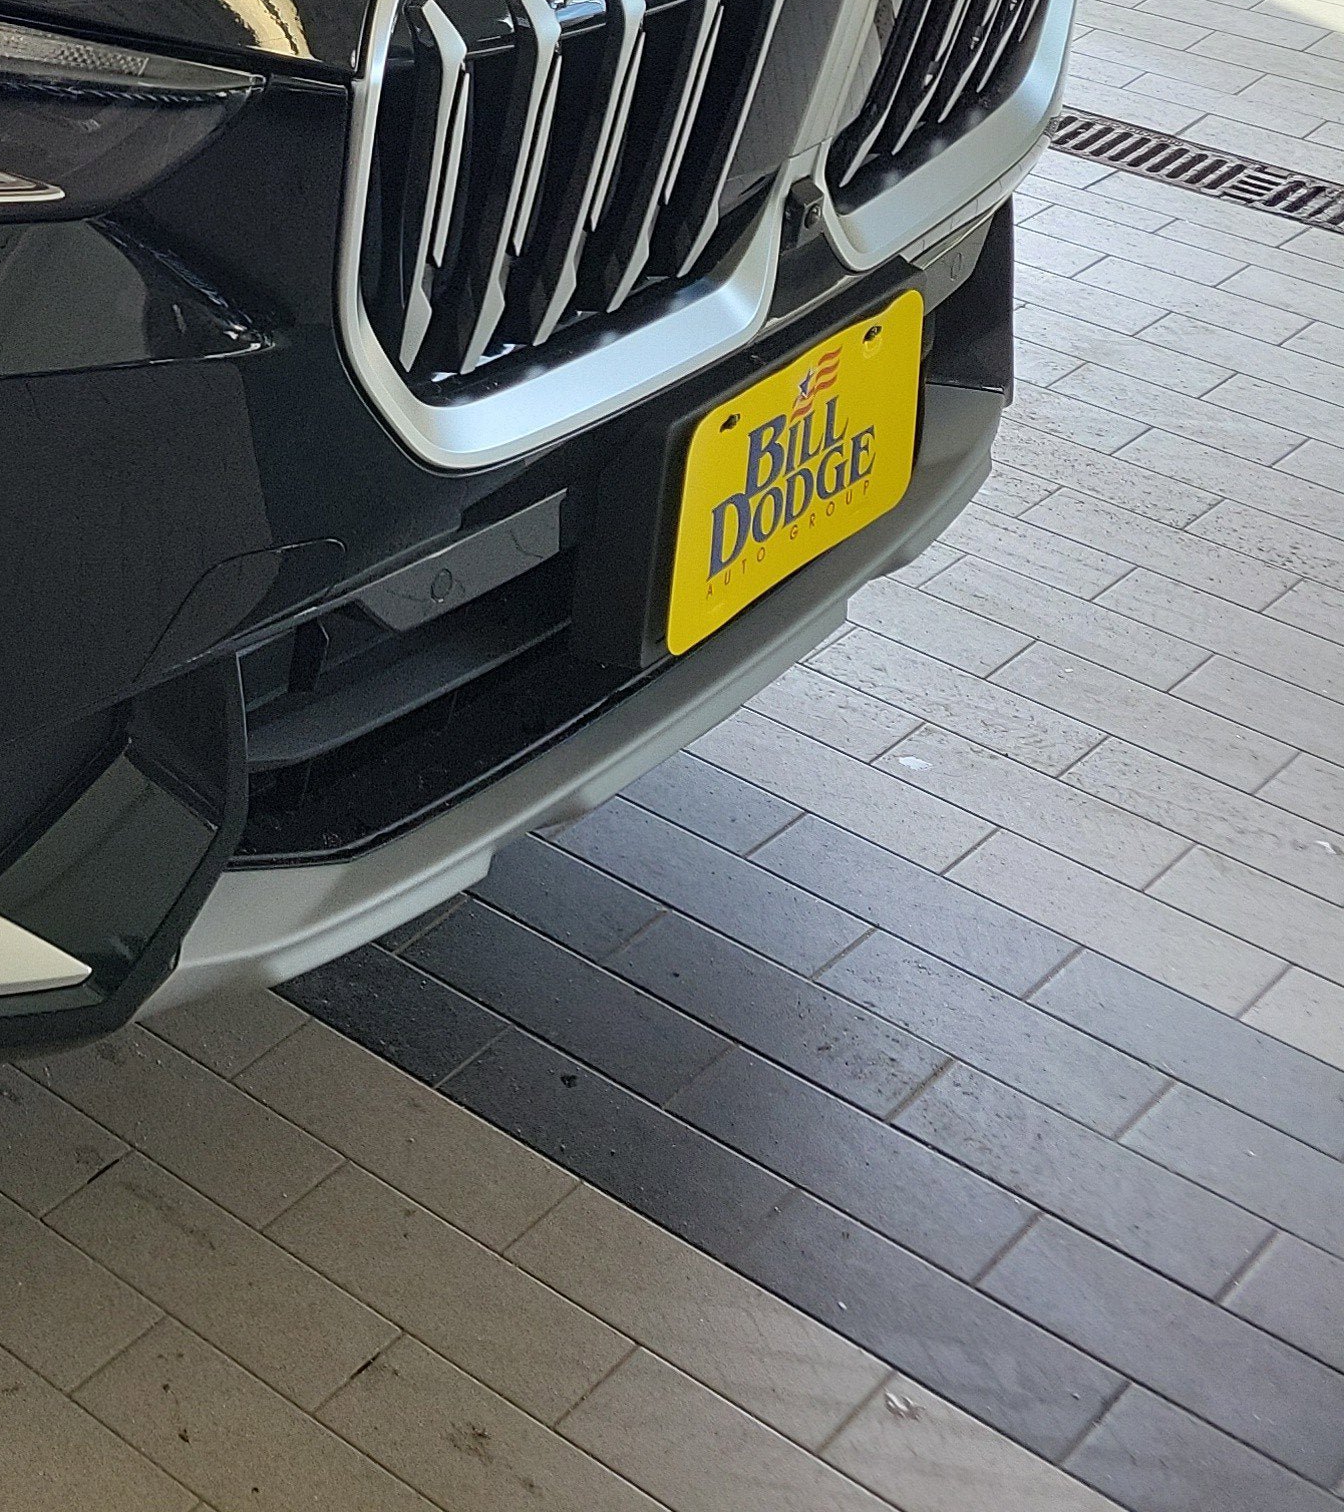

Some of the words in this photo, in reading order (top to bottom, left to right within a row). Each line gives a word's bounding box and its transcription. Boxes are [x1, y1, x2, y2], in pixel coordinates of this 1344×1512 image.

[705, 546, 766, 600] AUTO
[789, 479, 870, 540] GROUP
[706, 424, 877, 582] DODGE
